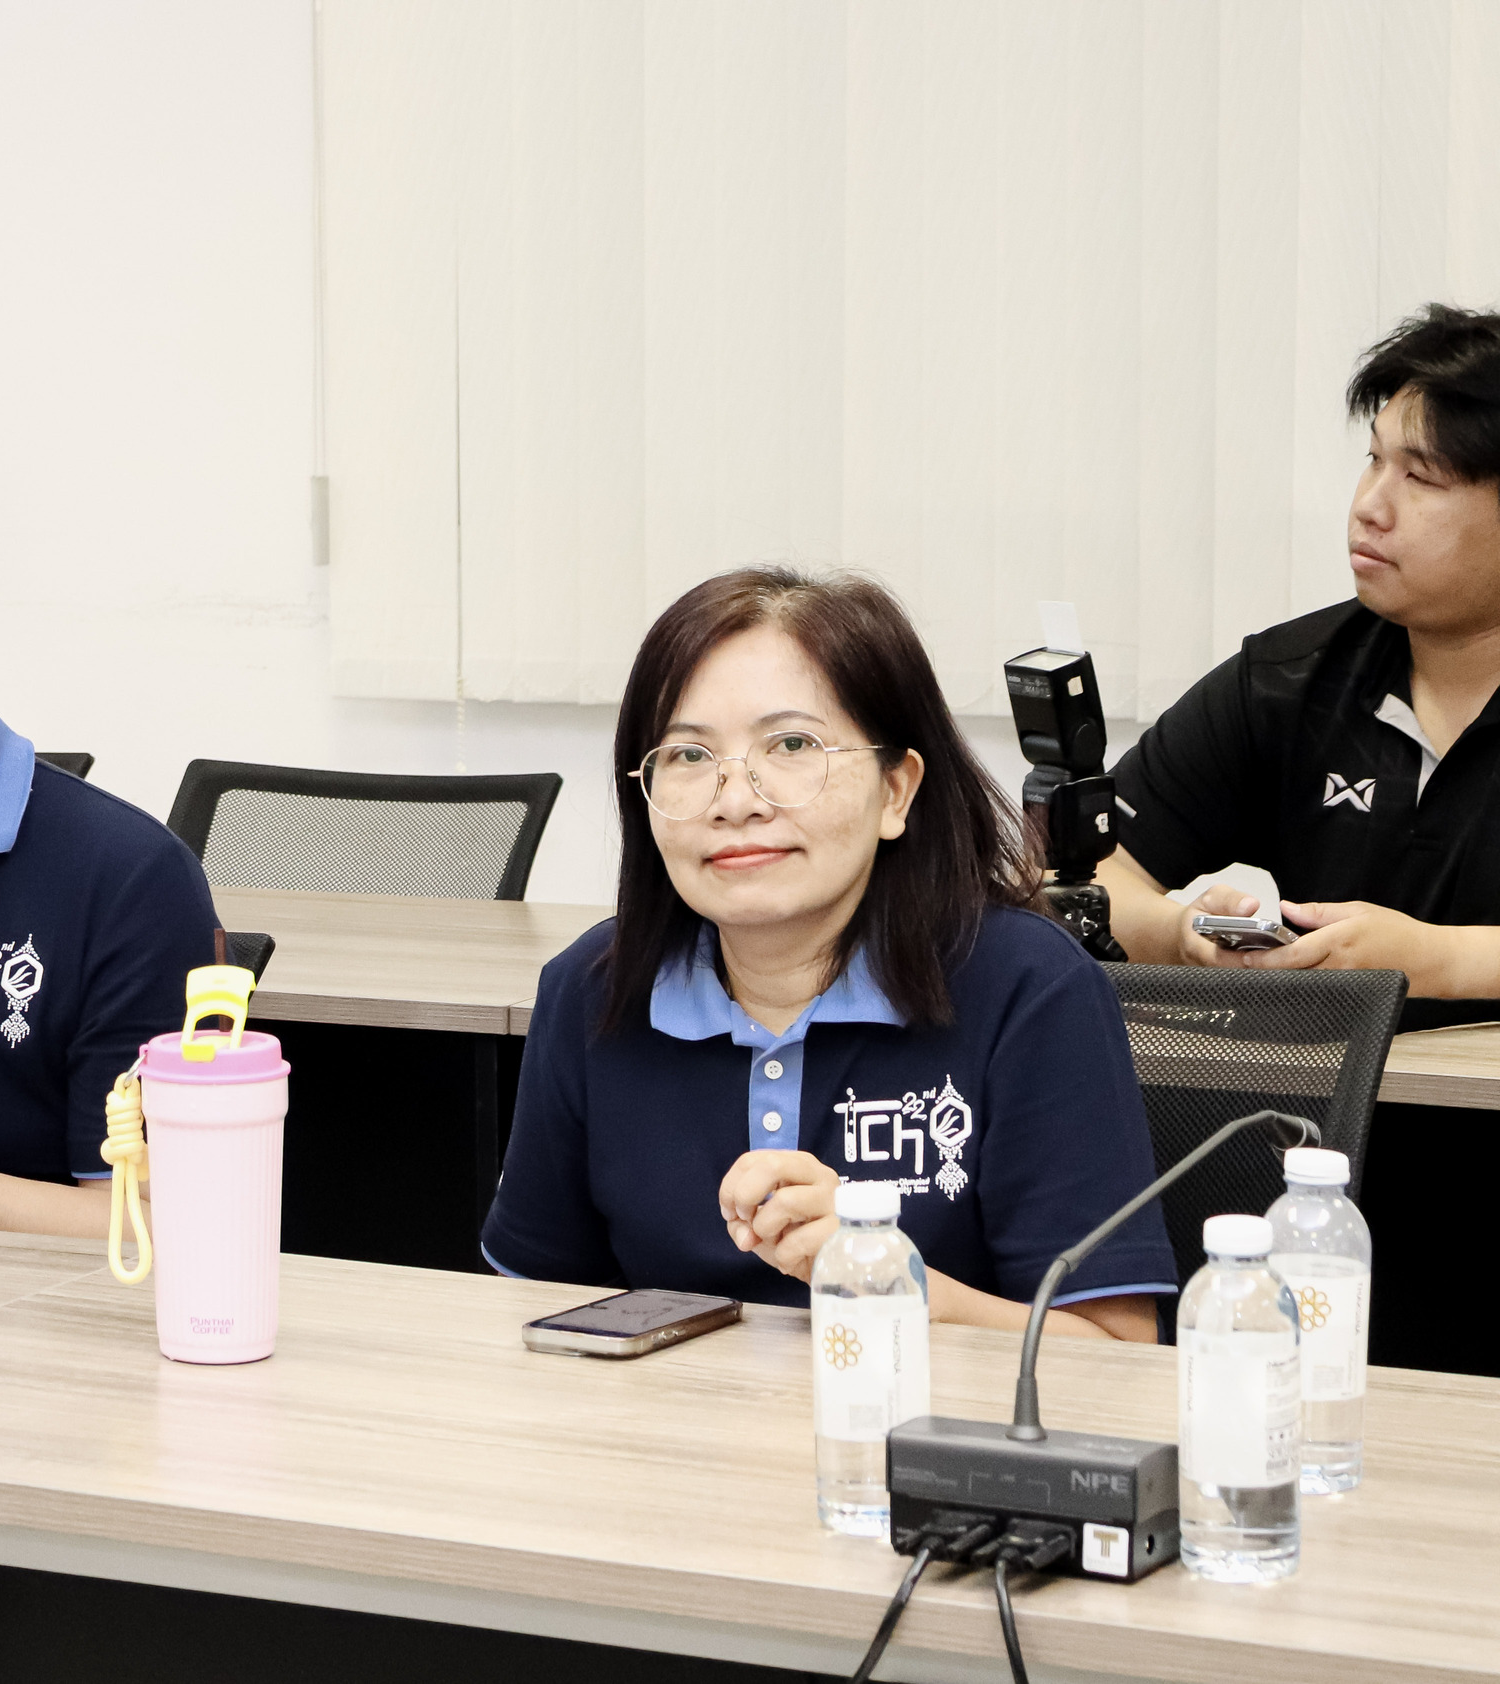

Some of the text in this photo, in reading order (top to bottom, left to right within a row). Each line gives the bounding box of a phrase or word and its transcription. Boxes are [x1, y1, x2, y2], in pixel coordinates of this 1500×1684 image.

[190, 1316, 234, 1326] PUNTHAI
[192, 1325, 231, 1335] COFFEE
[1070, 1469, 1130, 1493] NPE
